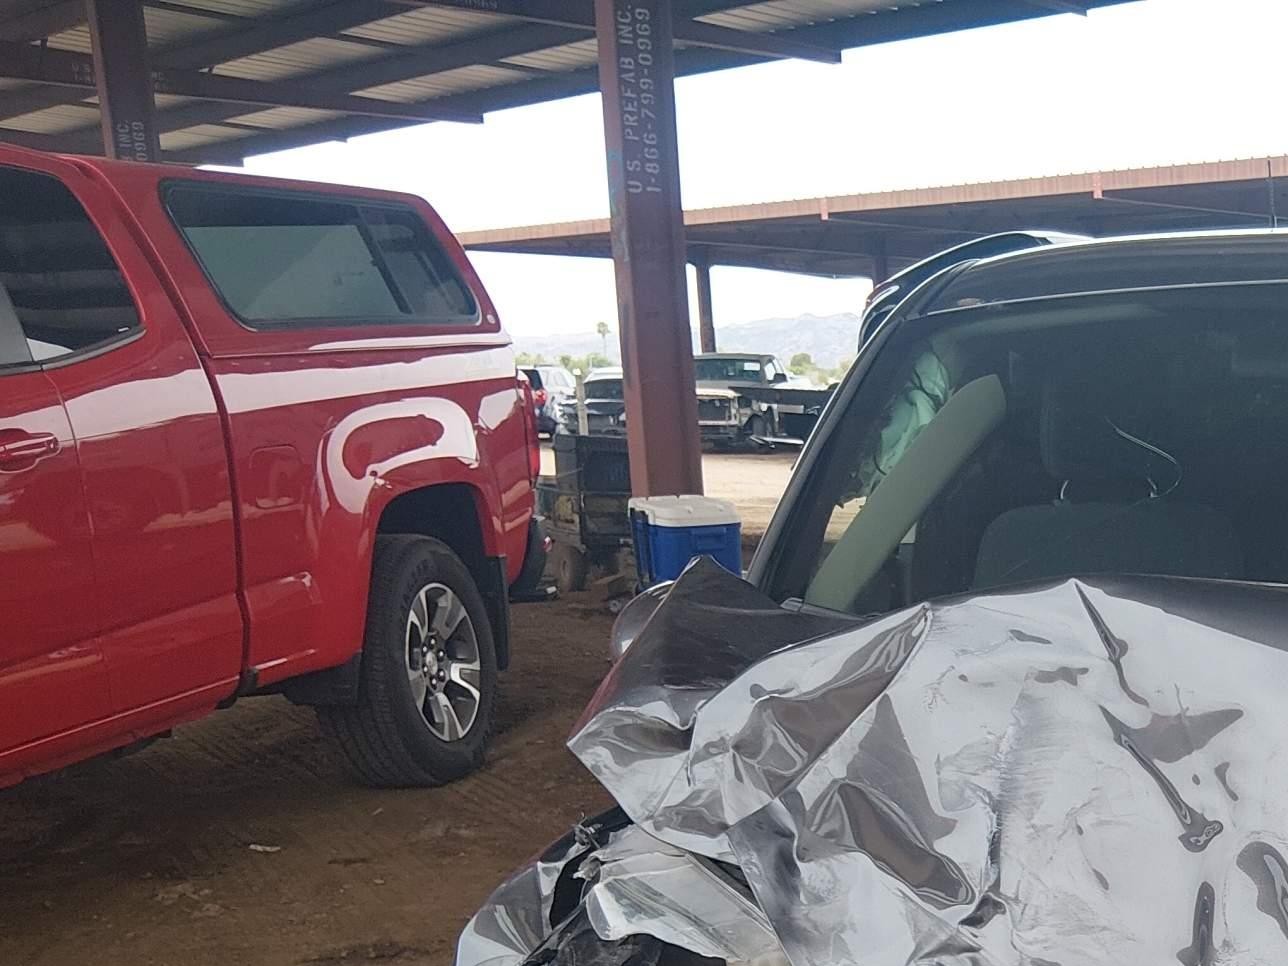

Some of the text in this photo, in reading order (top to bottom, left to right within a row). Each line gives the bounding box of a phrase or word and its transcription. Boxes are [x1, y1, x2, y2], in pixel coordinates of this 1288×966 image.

[617, 4, 634, 45] INC.
[620, 57, 640, 141] PREFAB
[635, 8, 662, 193] 1-866-799-0969
